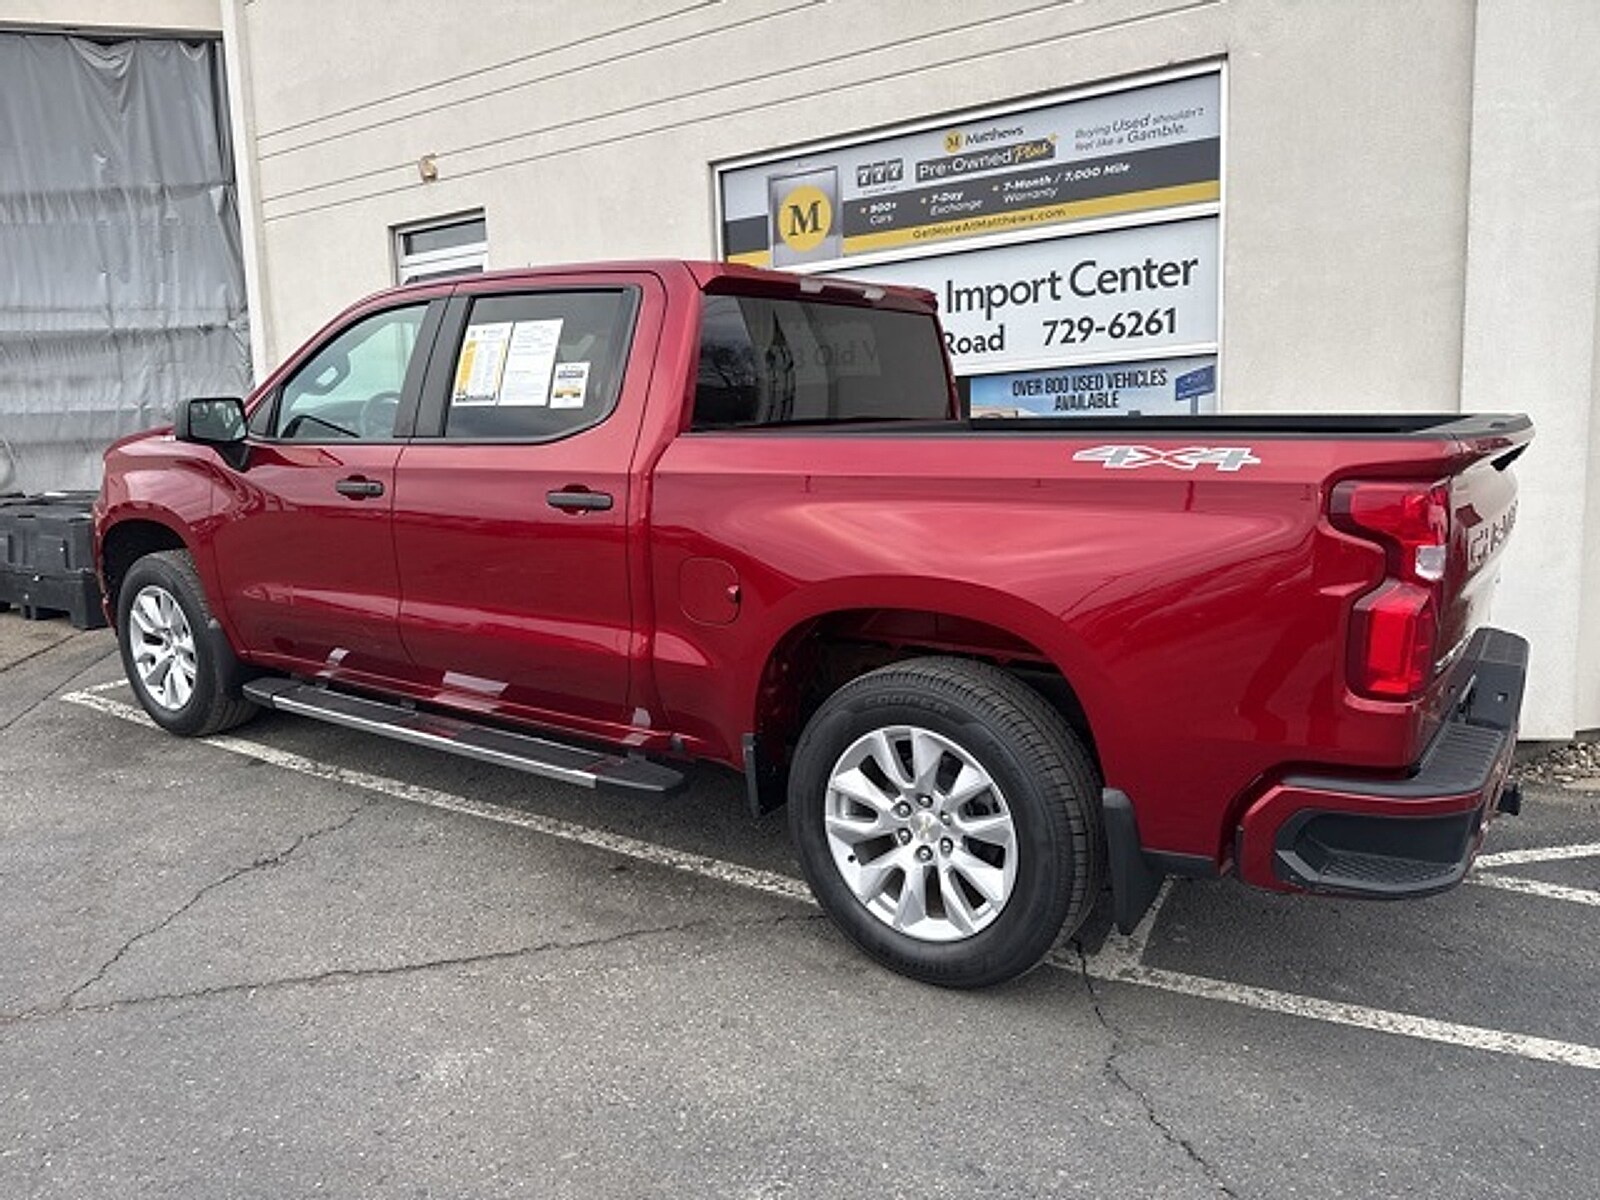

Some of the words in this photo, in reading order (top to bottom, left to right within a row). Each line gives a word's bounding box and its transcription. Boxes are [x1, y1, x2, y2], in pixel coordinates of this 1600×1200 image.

[1112, 113, 1151, 133] Used
[965, 125, 1024, 146] Matthews
[1103, 162, 1131, 176] Mile
[1003, 187, 1059, 204] Warranty
[787, 200, 824, 236] M
[930, 200, 983, 216] Exchange
[945, 270, 1063, 321] Import
[1069, 257, 1199, 298] Center
[1042, 306, 1177, 347] 729-6261
[1012, 377, 1043, 397] OVER
[1072, 373, 1103, 393] USED
[1105, 368, 1168, 390] VEHICLES
[1053, 391, 1120, 411] AVAILABLE
